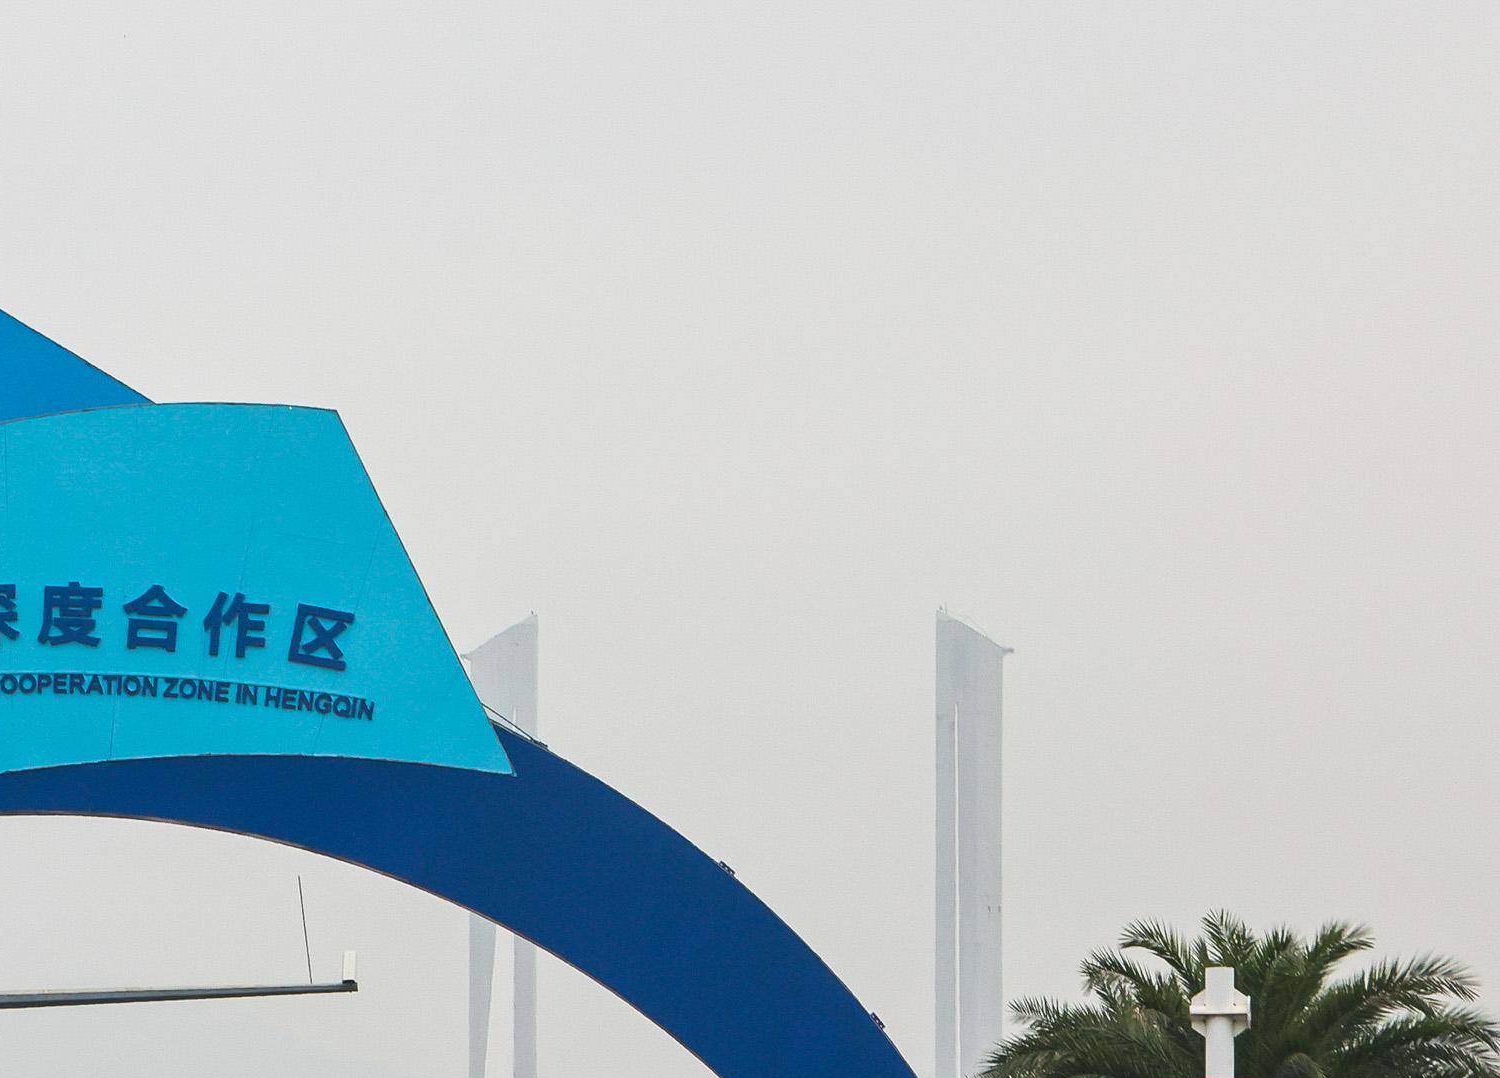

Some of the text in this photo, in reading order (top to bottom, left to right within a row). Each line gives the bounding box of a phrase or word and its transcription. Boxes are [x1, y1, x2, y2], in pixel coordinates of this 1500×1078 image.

[162, 678, 231, 704] ZONE
[235, 684, 258, 707] IN
[264, 687, 376, 721] HENGQIN
